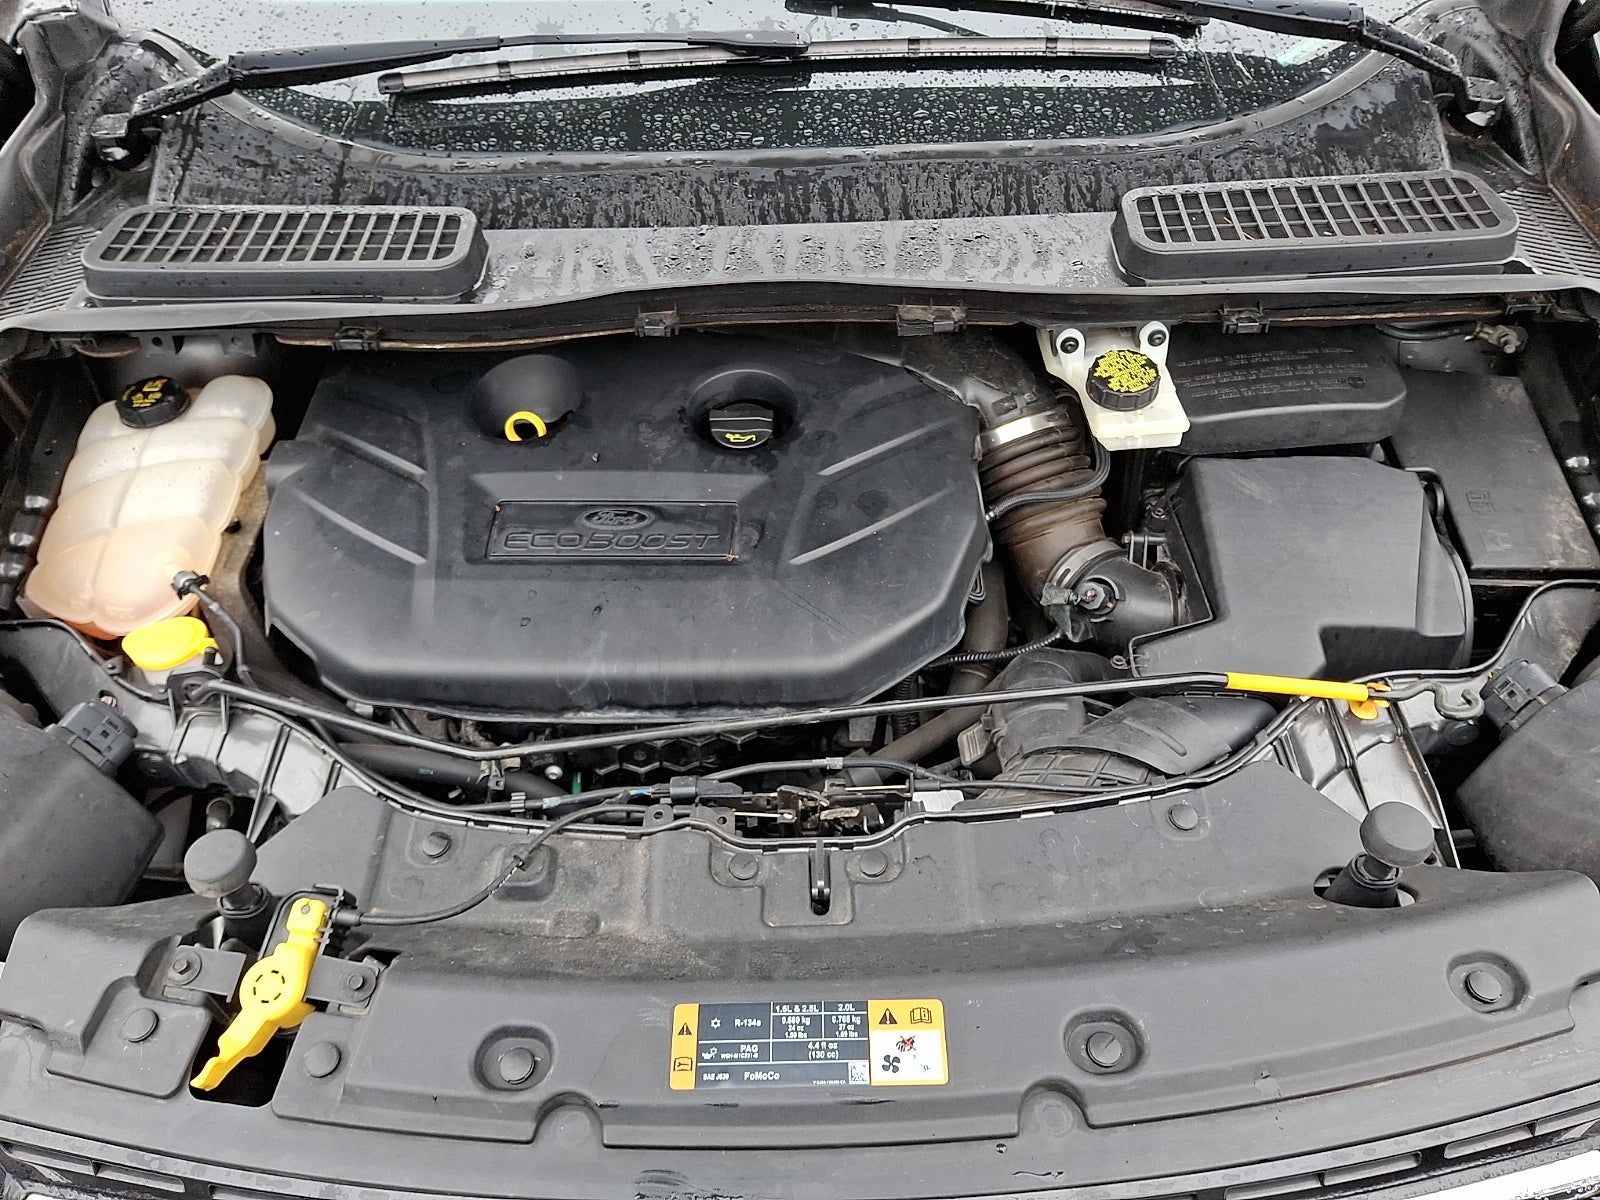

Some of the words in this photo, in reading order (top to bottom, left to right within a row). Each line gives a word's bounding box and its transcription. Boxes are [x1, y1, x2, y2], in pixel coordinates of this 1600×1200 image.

[592, 509, 639, 526] Ford
[503, 531, 720, 551] ECOBOOST
[837, 1003, 855, 1012] 2.0L
[802, 1016, 811, 1026] kg
[851, 1015, 861, 1025] kg
[740, 1044, 759, 1053] PAG
[807, 1042, 820, 1050] 4.4
[827, 1042, 838, 1050] oz
[808, 1051, 825, 1061] (130
[826, 1050, 839, 1060] cc)
[743, 1071, 781, 1081] FoMoCo
